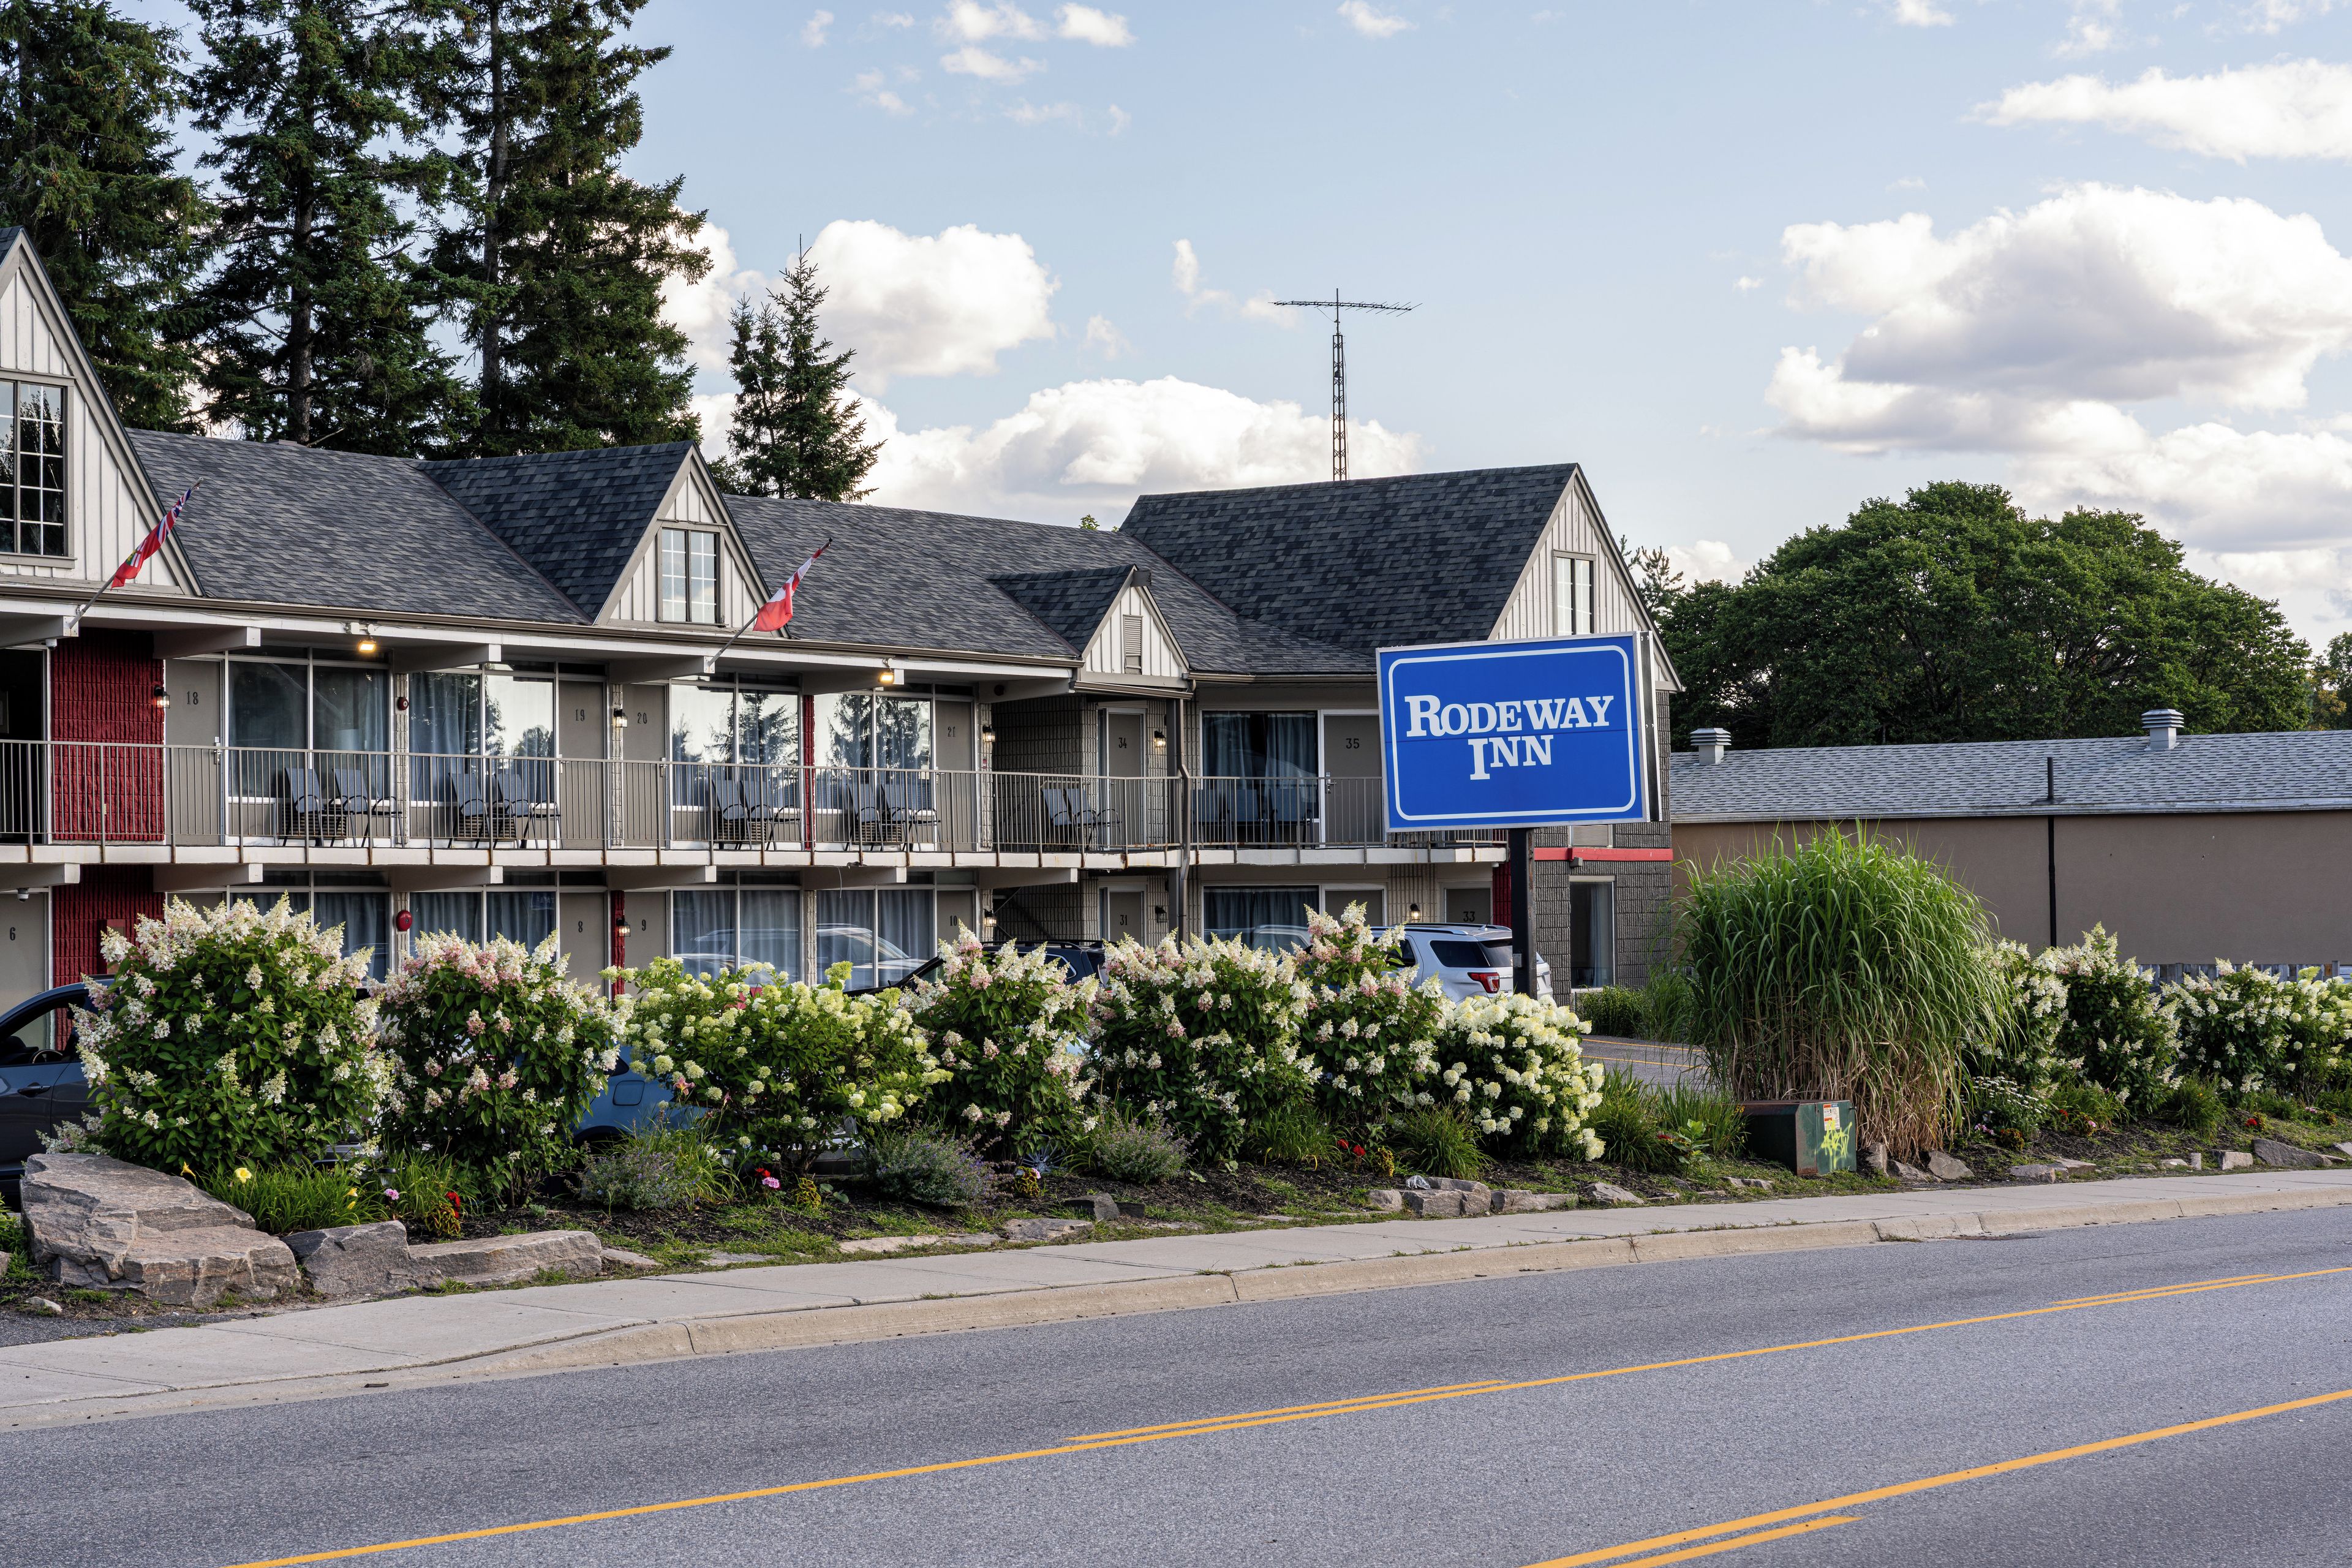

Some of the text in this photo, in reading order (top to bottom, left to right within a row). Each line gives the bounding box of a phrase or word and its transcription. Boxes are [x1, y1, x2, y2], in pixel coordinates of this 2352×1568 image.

[187, 691, 199, 705] 18
[575, 709, 586, 722] 19
[637, 712, 647, 724] 20
[1404, 695, 1614, 737] RODEWAY
[948, 726, 956, 737] 21
[1118, 737, 1127, 748] 34
[1346, 738, 1360, 748] 35
[1468, 735, 1554, 780] INN
[950, 915, 957, 926] 10
[1120, 914, 1128, 925] 31
[1463, 911, 1476, 922] 33
[578, 921, 583, 933] 8
[641, 919, 647, 931] 9
[9, 927, 16, 941] 6
